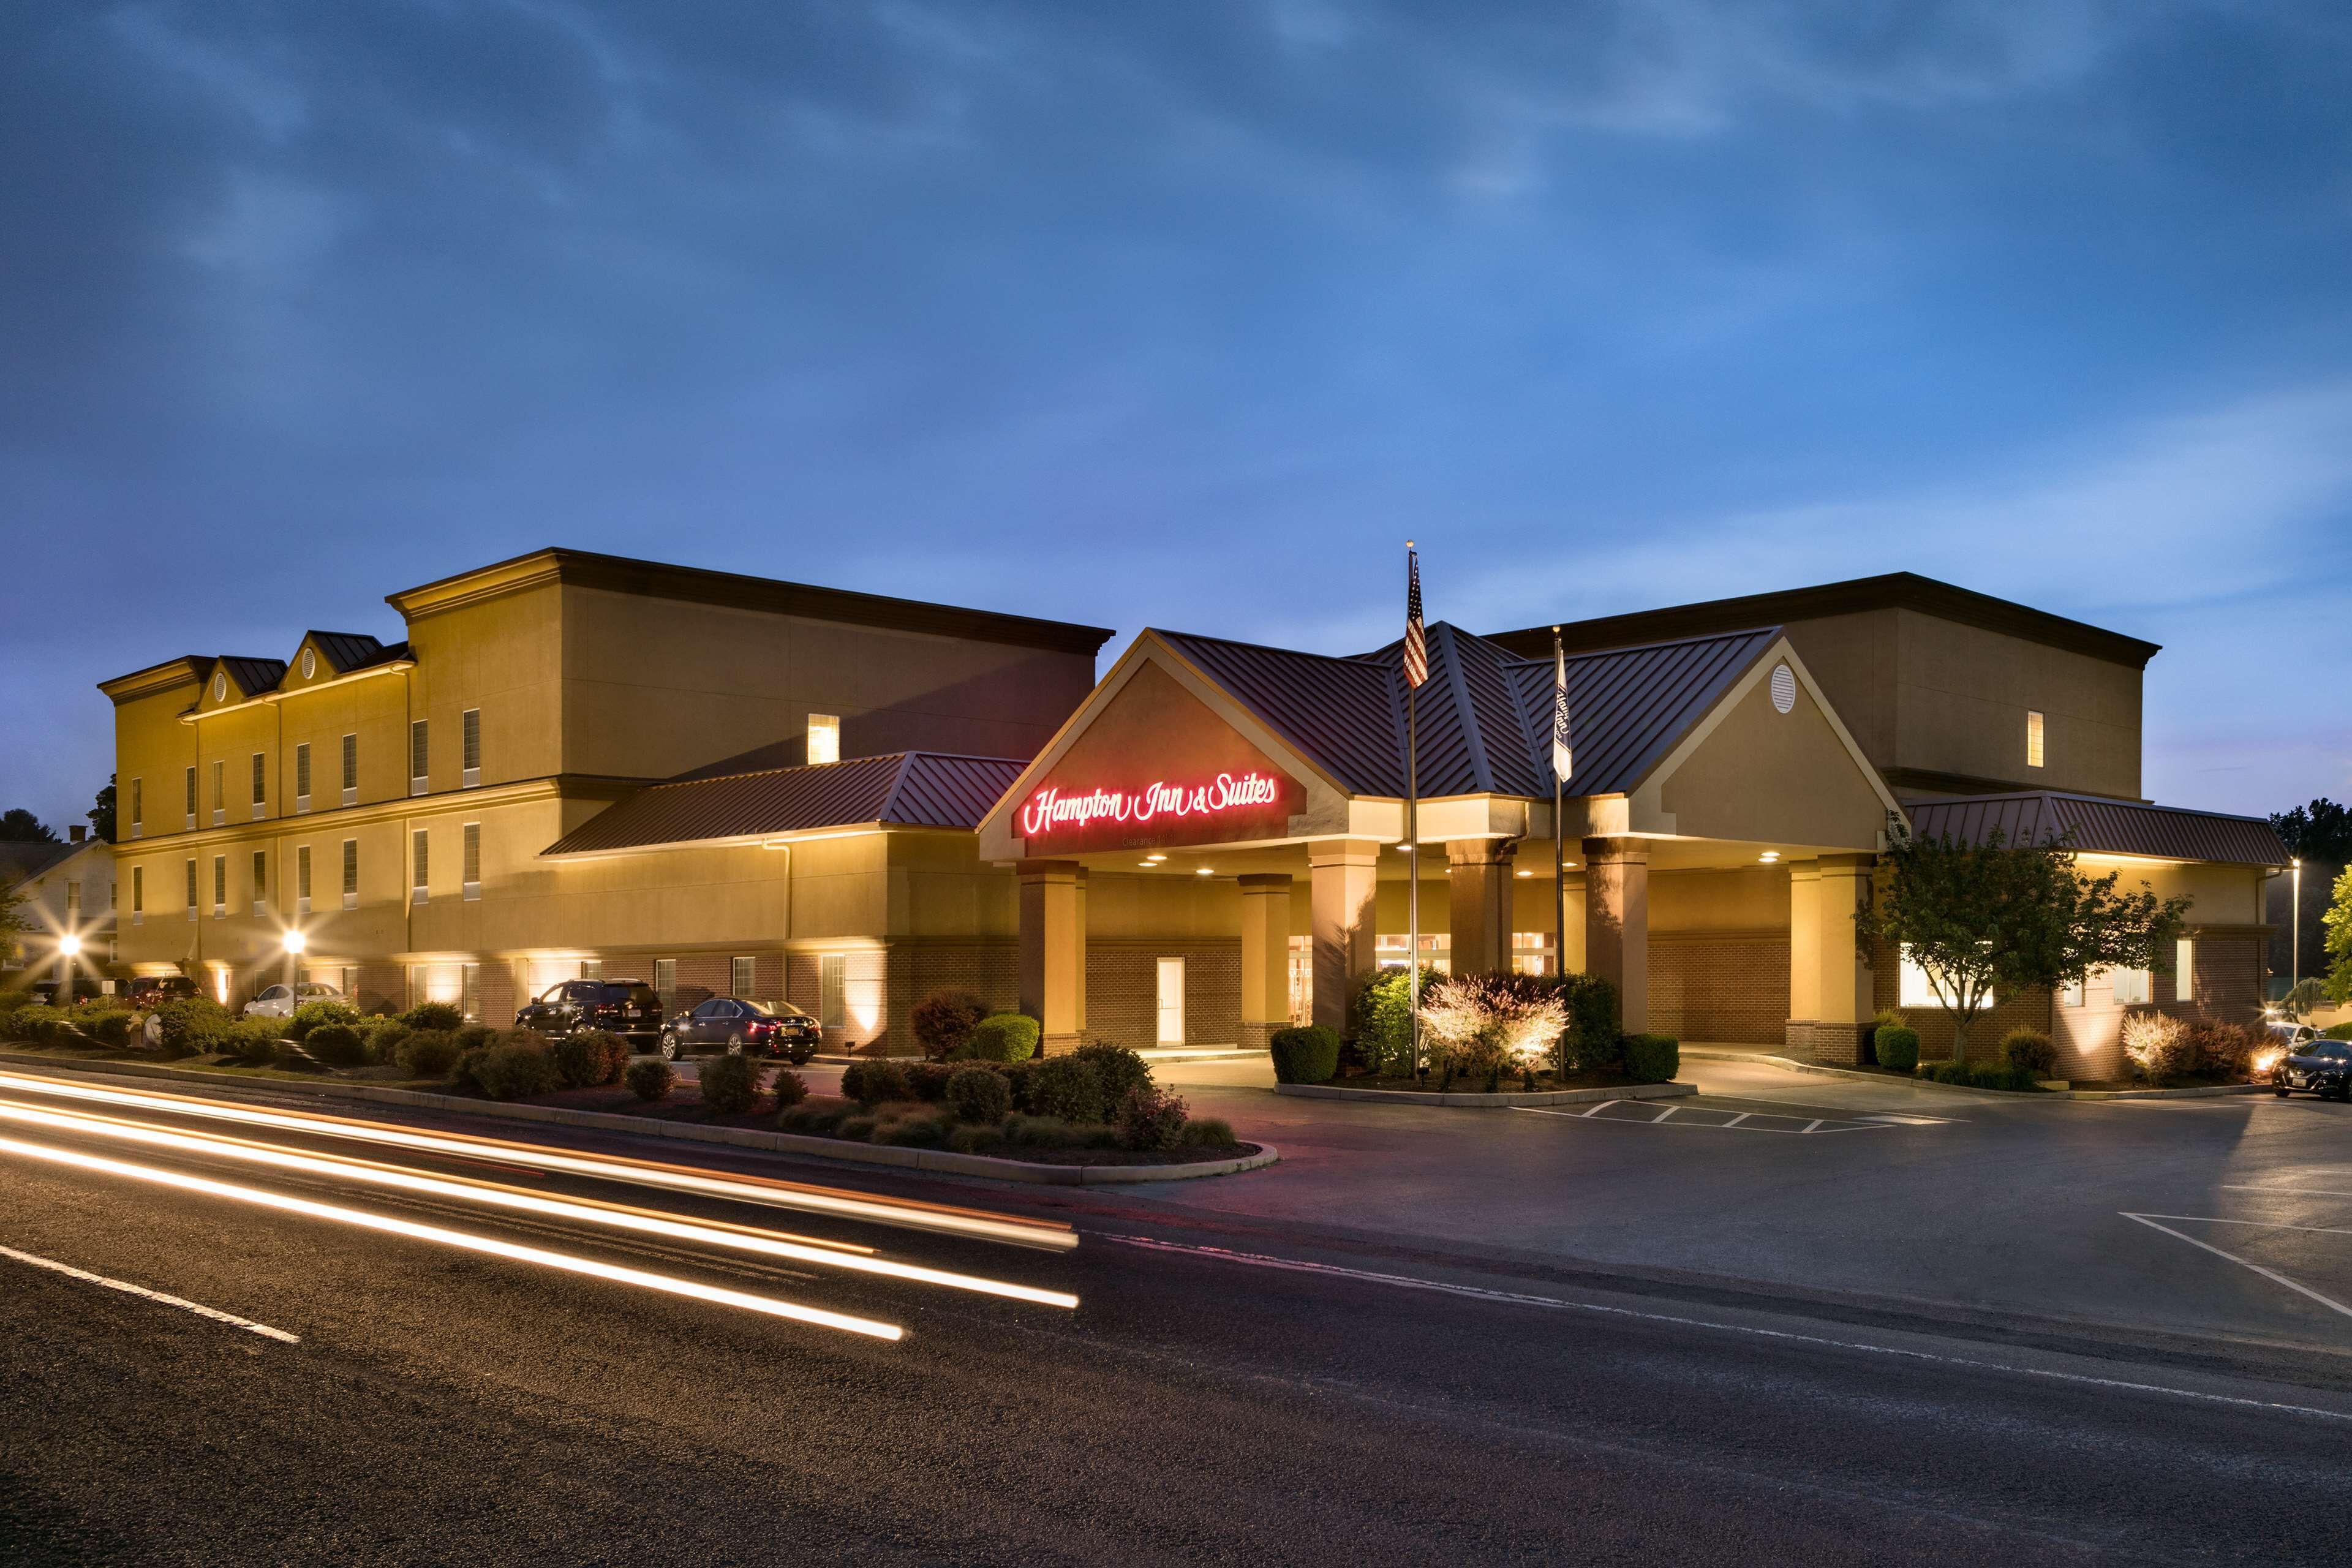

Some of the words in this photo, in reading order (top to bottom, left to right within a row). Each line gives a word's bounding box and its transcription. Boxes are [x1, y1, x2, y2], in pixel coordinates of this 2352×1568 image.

[1024, 787, 1132, 834] Hampton
[1134, 781, 1193, 821] Inn
[1193, 788, 1209, 813] &
[1207, 772, 1275, 810] Suites
[1122, 837, 1156, 847] Clearance
